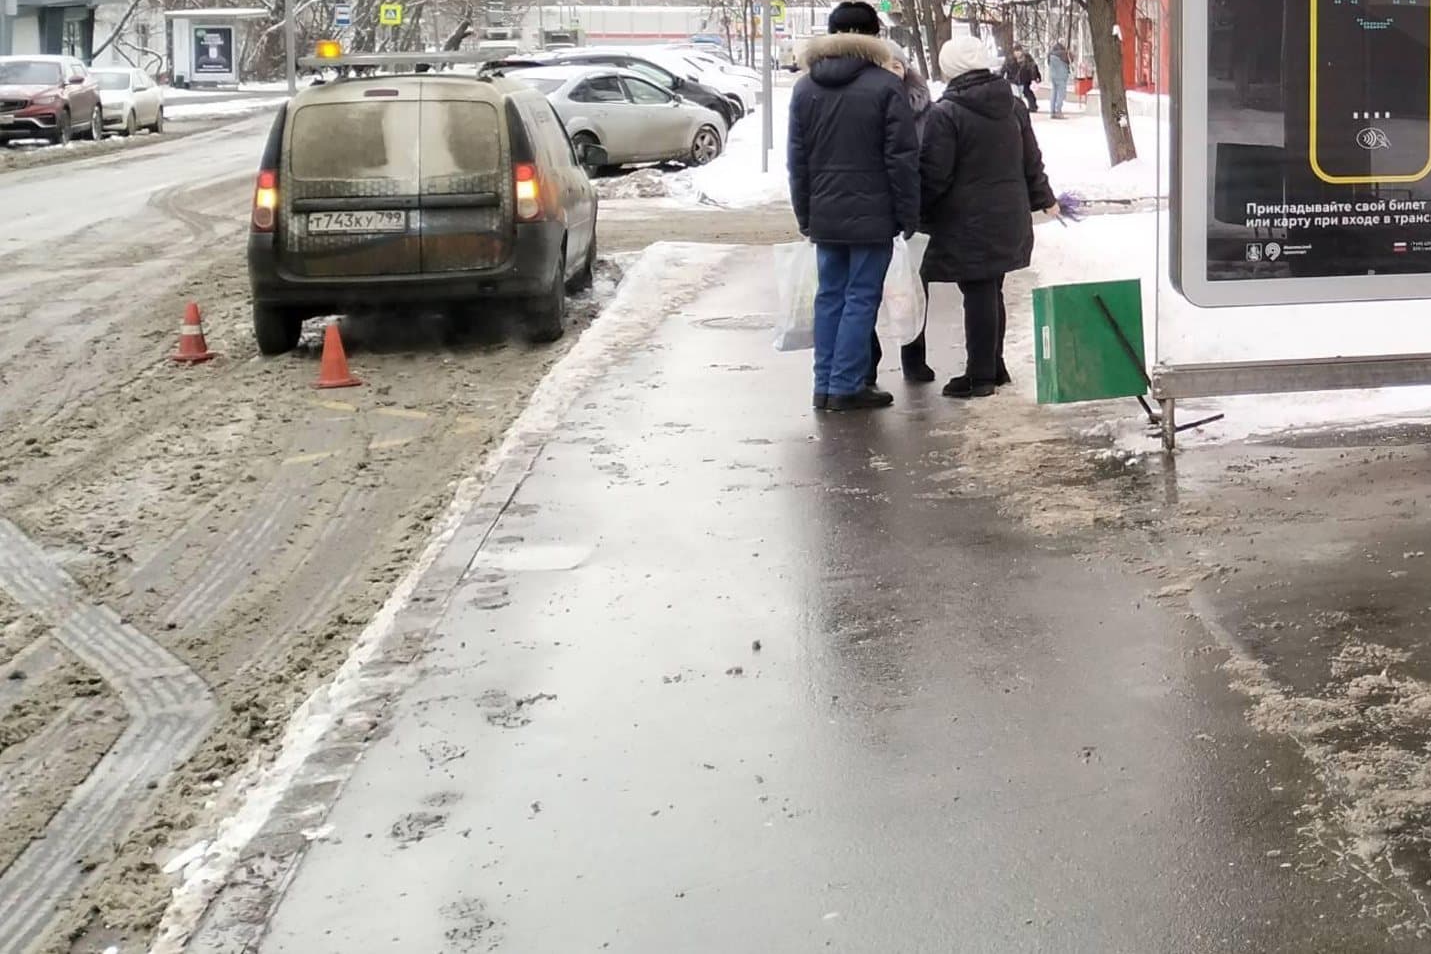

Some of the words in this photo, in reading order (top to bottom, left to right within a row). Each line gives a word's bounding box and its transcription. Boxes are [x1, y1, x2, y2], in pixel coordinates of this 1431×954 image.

[1246, 200, 1351, 215] Прикладывайте
[1355, 199, 1385, 212] свой
[1388, 198, 1427, 212] билет
[1246, 217, 1271, 228] или
[1274, 216, 1311, 230] карту
[1314, 215, 1339, 228] при
[1342, 214, 1380, 227] входе
[1383, 215, 1391, 224] в
